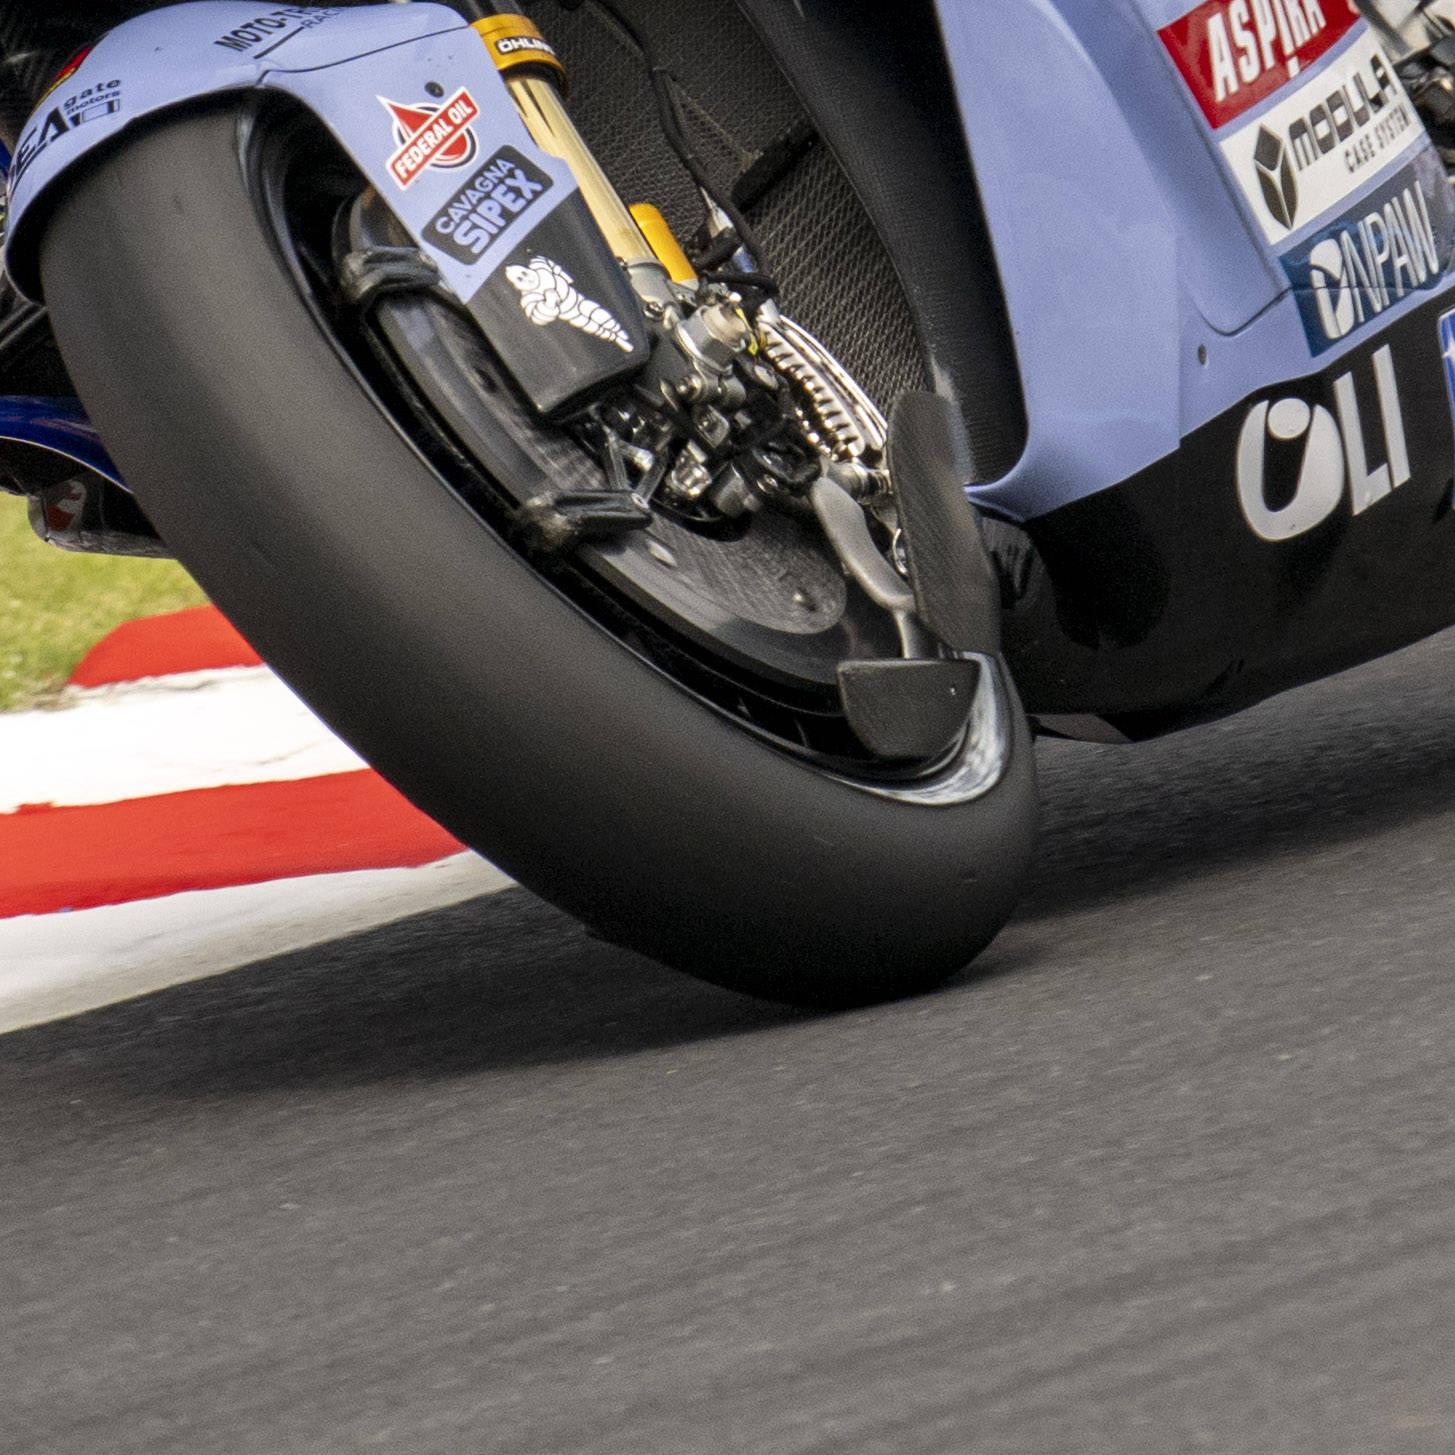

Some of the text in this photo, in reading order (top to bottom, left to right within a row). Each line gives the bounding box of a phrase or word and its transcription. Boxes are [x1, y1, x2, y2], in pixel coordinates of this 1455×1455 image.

[63, 80, 121, 110] gate
[67, 91, 120, 116] motors
[394, 101, 474, 179] FEDERAL OIL
[436, 158, 515, 234] CAVAGNA
[453, 169, 542, 254] SIPEX
